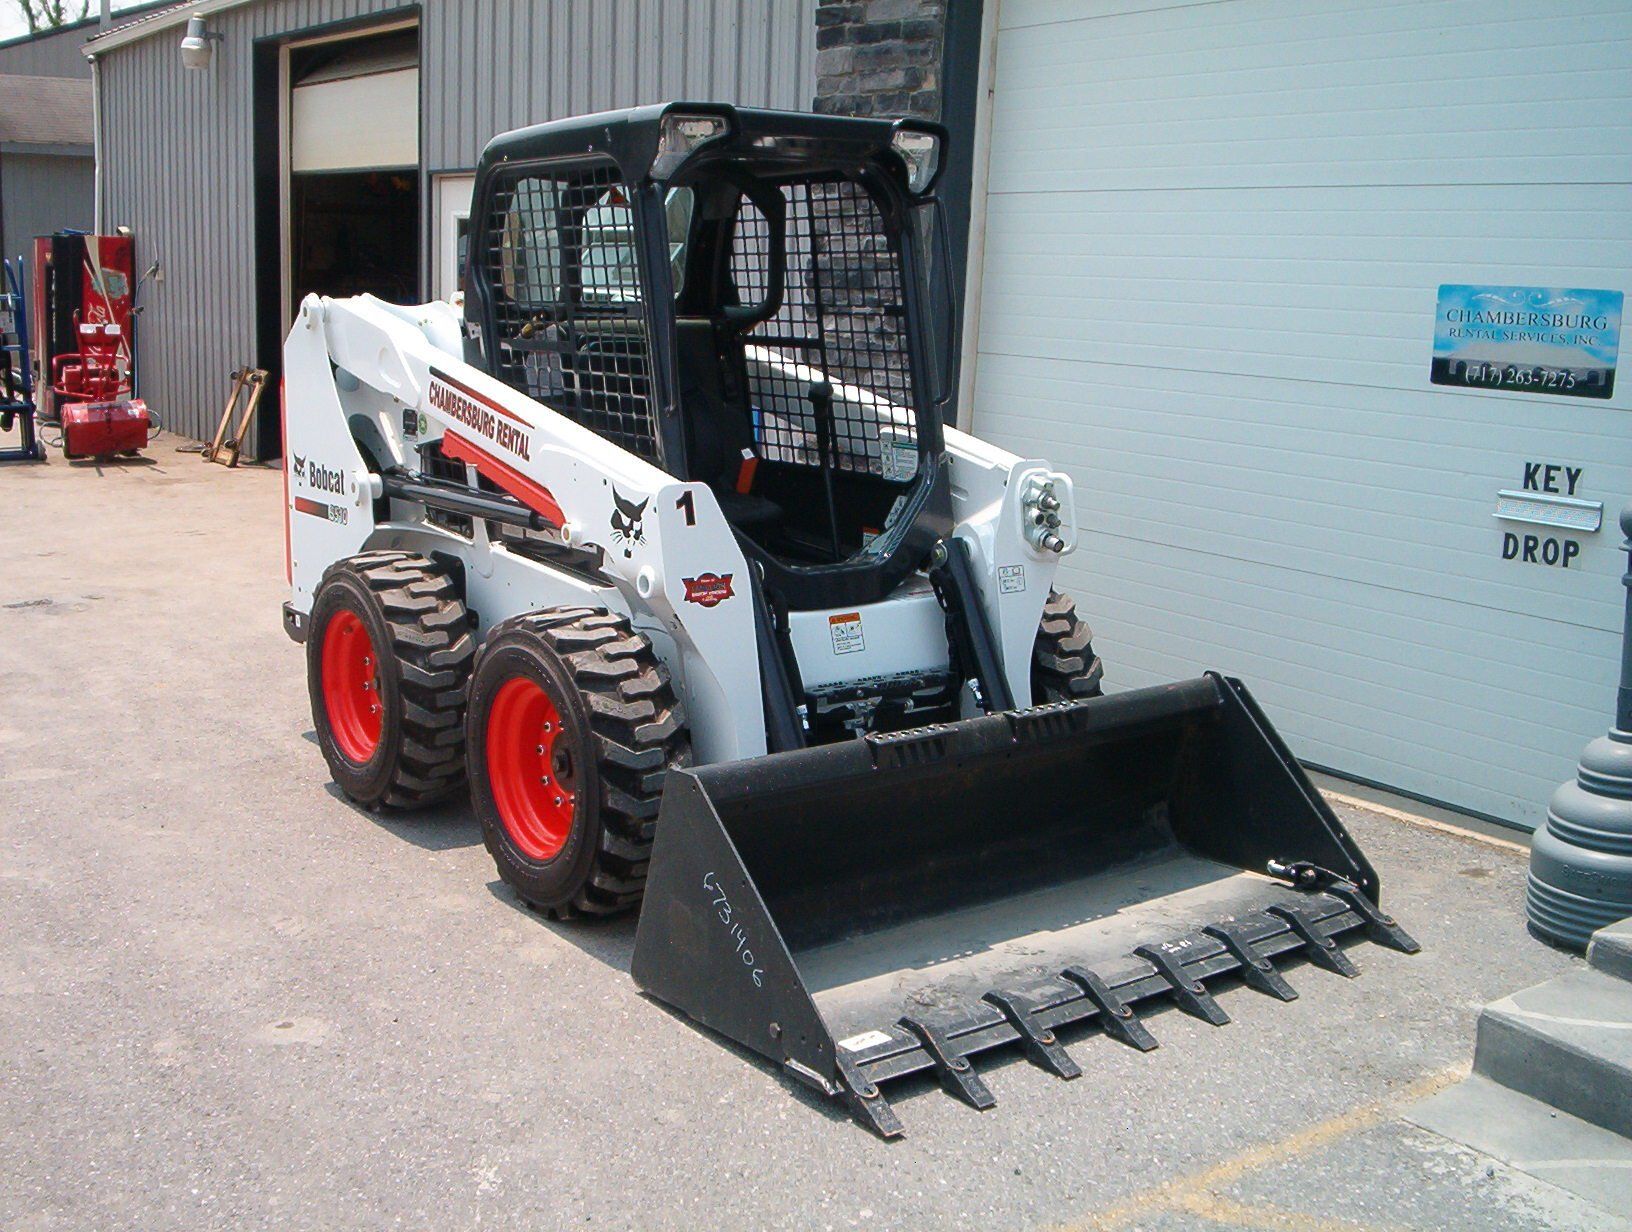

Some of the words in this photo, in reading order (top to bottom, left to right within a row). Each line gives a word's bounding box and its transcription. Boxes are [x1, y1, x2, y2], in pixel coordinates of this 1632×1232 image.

[1446, 308, 1608, 331] CHAMBERSBURG
[1449, 328, 1497, 340] RENTAL
[1465, 366, 1503, 385] (717)
[1507, 367, 1576, 389] 263-7275
[429, 380, 496, 440] CHAMBERSBURG
[496, 418, 531, 463] RENTAL
[309, 461, 345, 496] Bobcat
[1523, 462, 1583, 496] KEY
[675, 490, 697, 526] 1
[1502, 532, 1580, 568] DROP
[703, 871, 764, 988] 6731406
